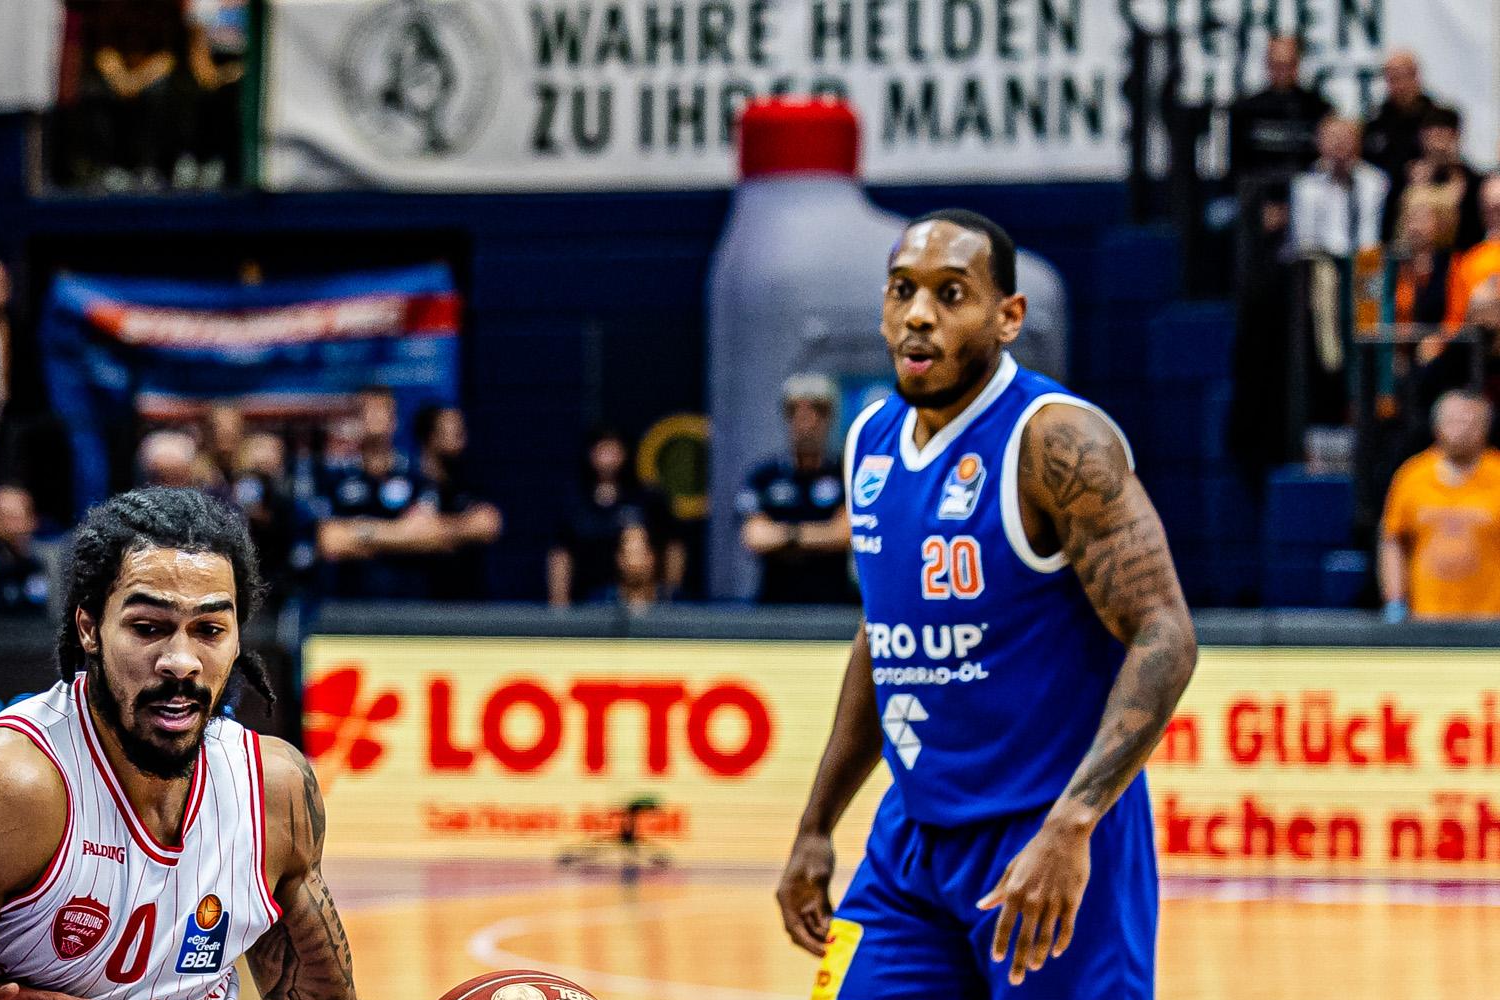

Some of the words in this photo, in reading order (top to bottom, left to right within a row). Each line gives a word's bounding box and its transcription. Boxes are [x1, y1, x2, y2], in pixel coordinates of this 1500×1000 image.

[530, 2, 772, 66] WAHRE
[812, 0, 1080, 62] HELDEN
[533, 80, 612, 152] ZU
[921, 535, 985, 600] 20
[426, 676, 774, 778] LOTTO
[1227, 690, 1413, 770] Glück
[105, 902, 156, 984] 0
[180, 951, 216, 968] BBL
